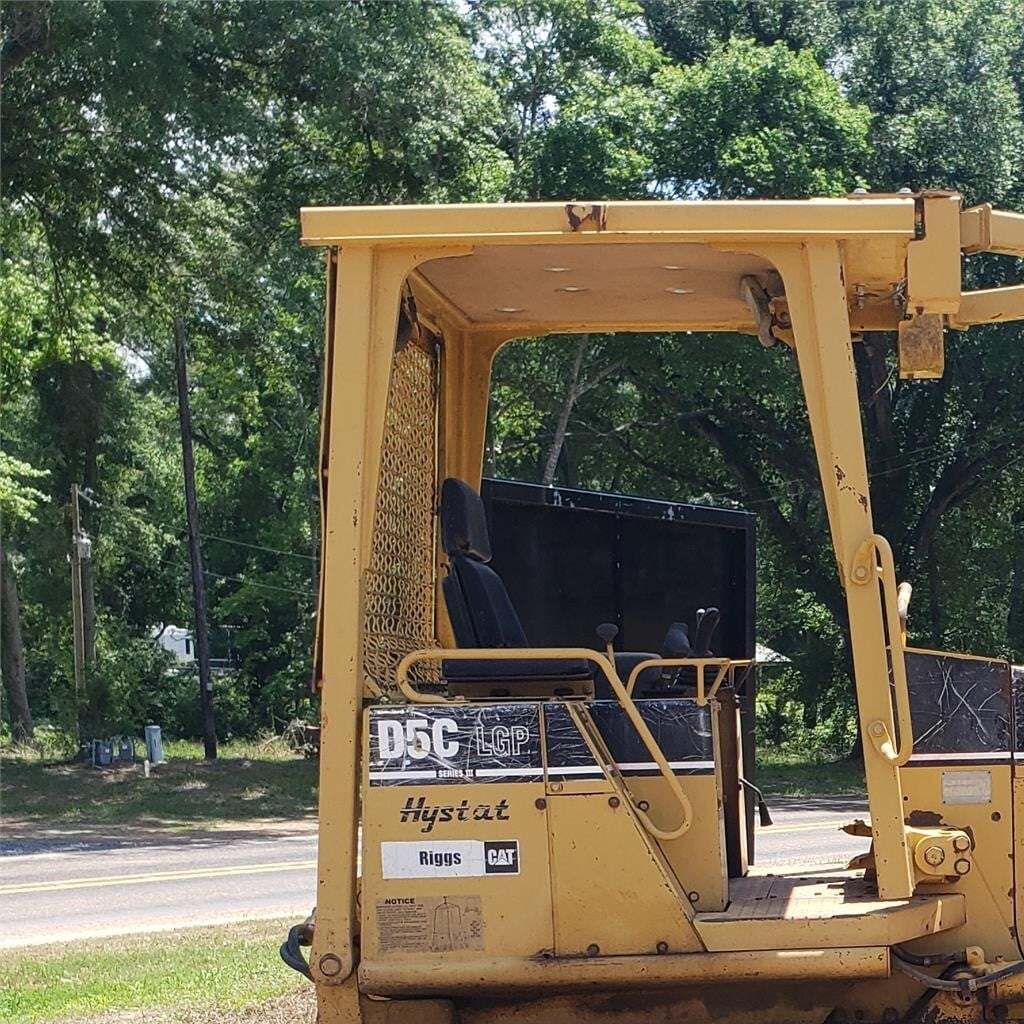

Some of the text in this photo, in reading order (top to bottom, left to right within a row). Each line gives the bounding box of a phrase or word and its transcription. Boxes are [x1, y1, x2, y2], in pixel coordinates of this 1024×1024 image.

[377, 718, 530, 760] D5C LGP
[438, 769, 463, 778] SERIES
[400, 797, 510, 833] Hystat
[419, 848, 515, 868] Riggs CAT
